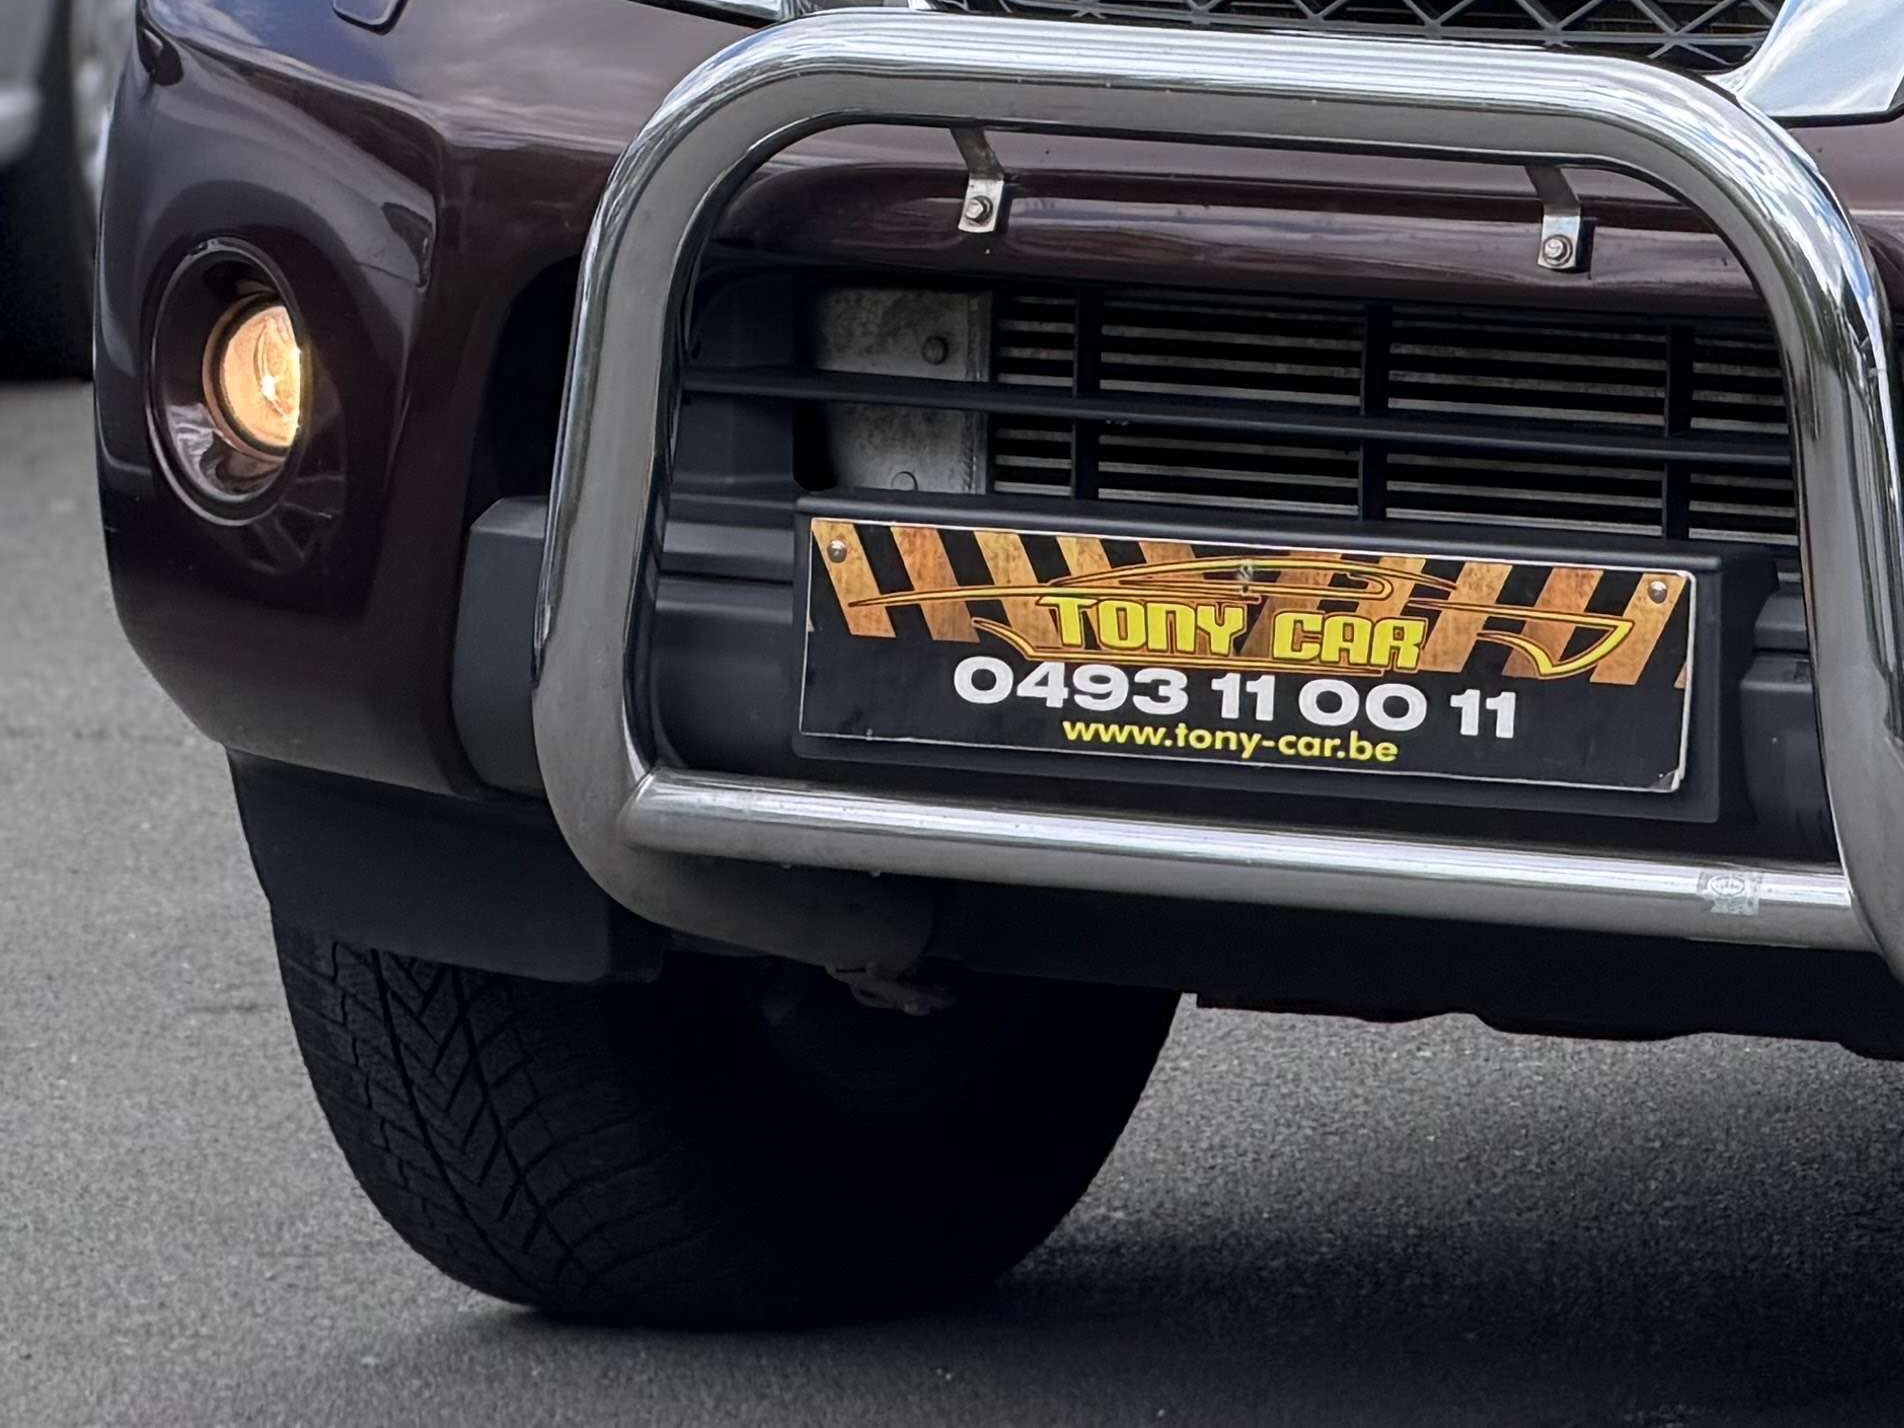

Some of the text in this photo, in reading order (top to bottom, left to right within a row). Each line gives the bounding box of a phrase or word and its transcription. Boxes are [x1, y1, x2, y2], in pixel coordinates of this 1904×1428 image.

[1035, 594, 1425, 671] TONY CAR
[952, 654, 1516, 739] 0493 11 00 11
[1062, 719, 1398, 762] www.tony-car.be
